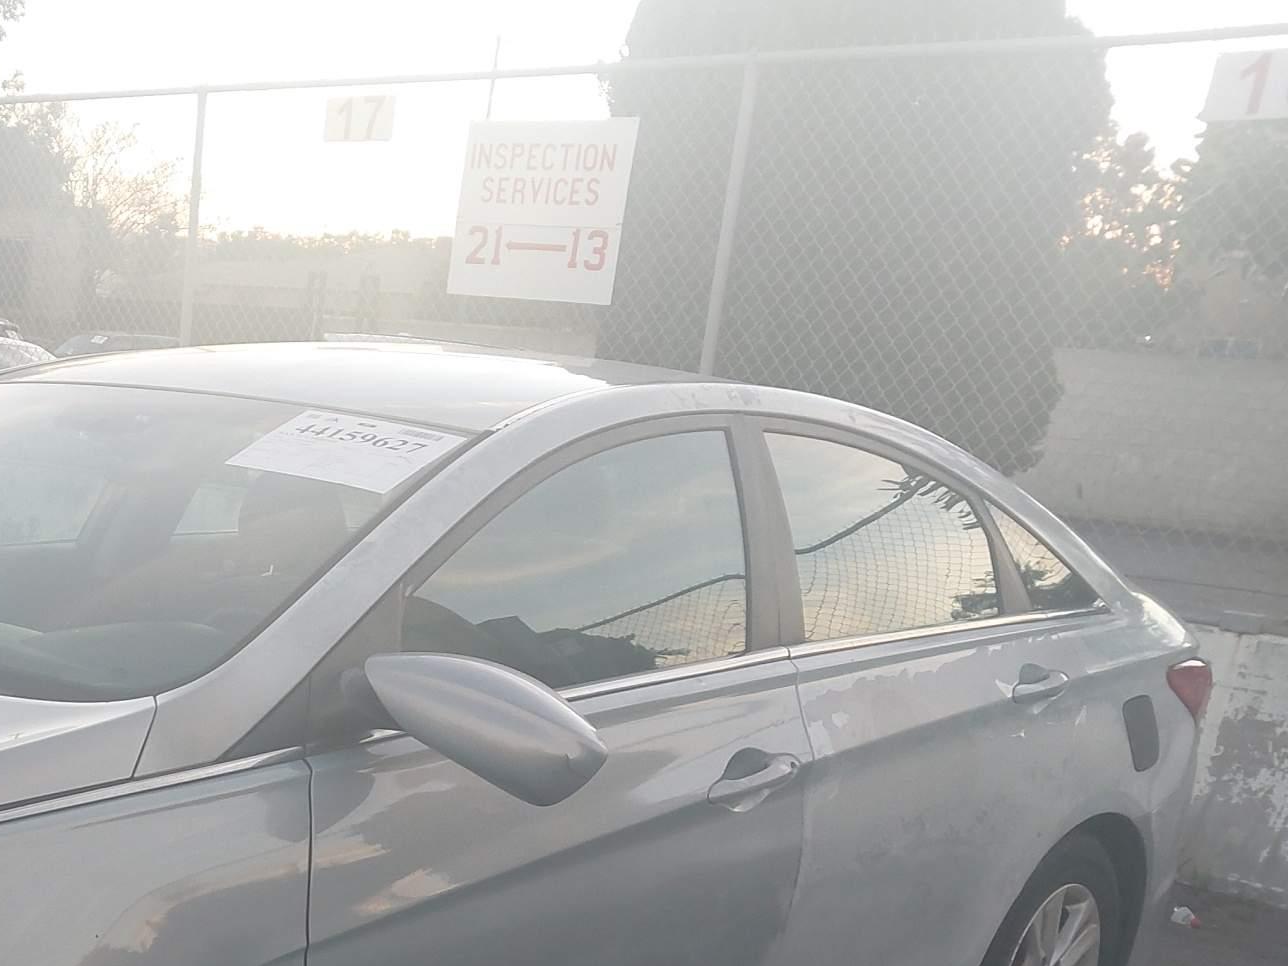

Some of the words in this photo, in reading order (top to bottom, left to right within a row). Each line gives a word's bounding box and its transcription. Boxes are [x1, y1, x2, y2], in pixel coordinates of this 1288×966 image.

[338, 96, 387, 140] 17
[469, 143, 618, 172] INSPECTION
[480, 176, 601, 207] SERVICES
[464, 225, 504, 266] 21
[567, 228, 610, 272] 13
[295, 424, 428, 454] 44159627
